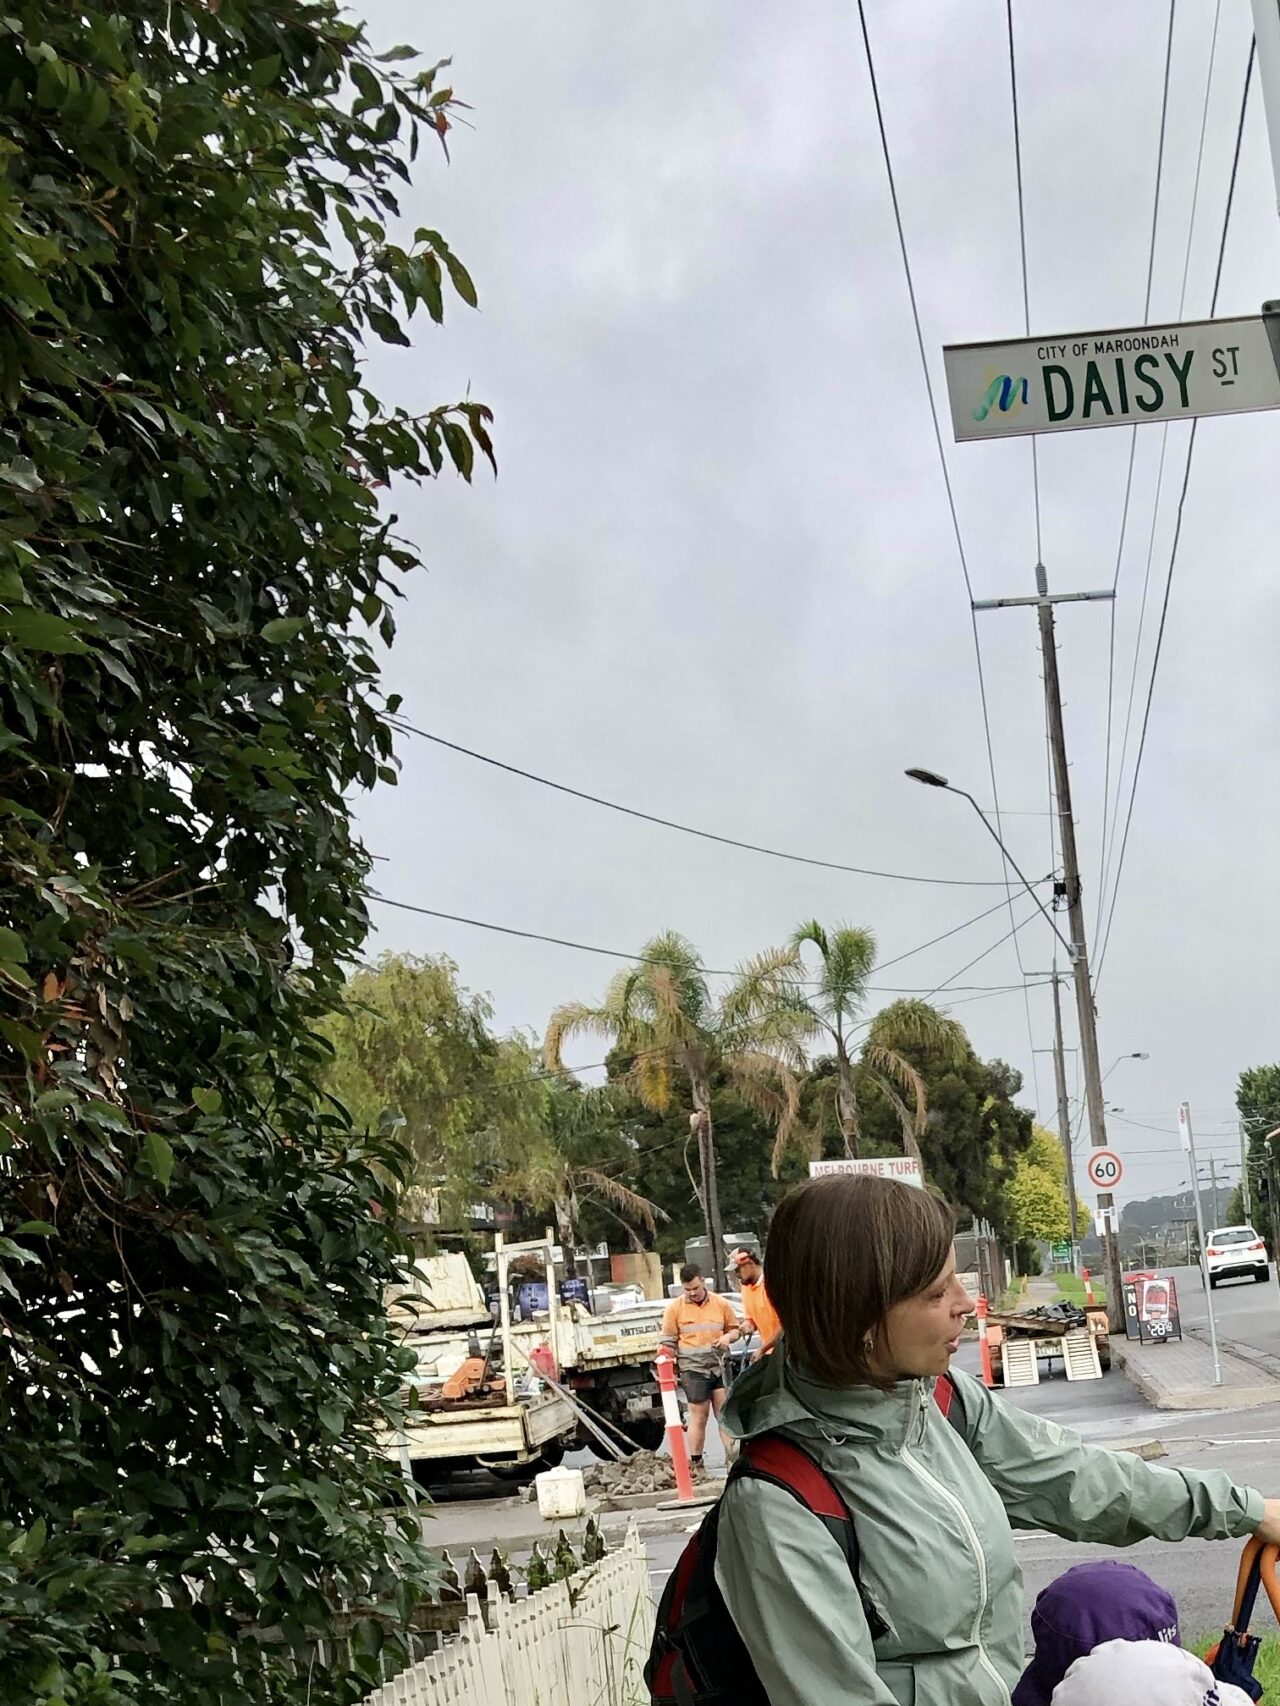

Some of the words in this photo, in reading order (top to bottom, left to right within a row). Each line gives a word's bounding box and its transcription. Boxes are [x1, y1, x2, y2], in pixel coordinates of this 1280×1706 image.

[1037, 345, 1066, 360] CITY
[1073, 342, 1088, 356] OF
[1095, 334, 1179, 354] MAROONDAH
[1042, 350, 1194, 422] DAISY
[1212, 347, 1240, 380] ST
[814, 1163, 884, 1177] MELBOURNE
[1095, 1162, 1116, 1178] 60
